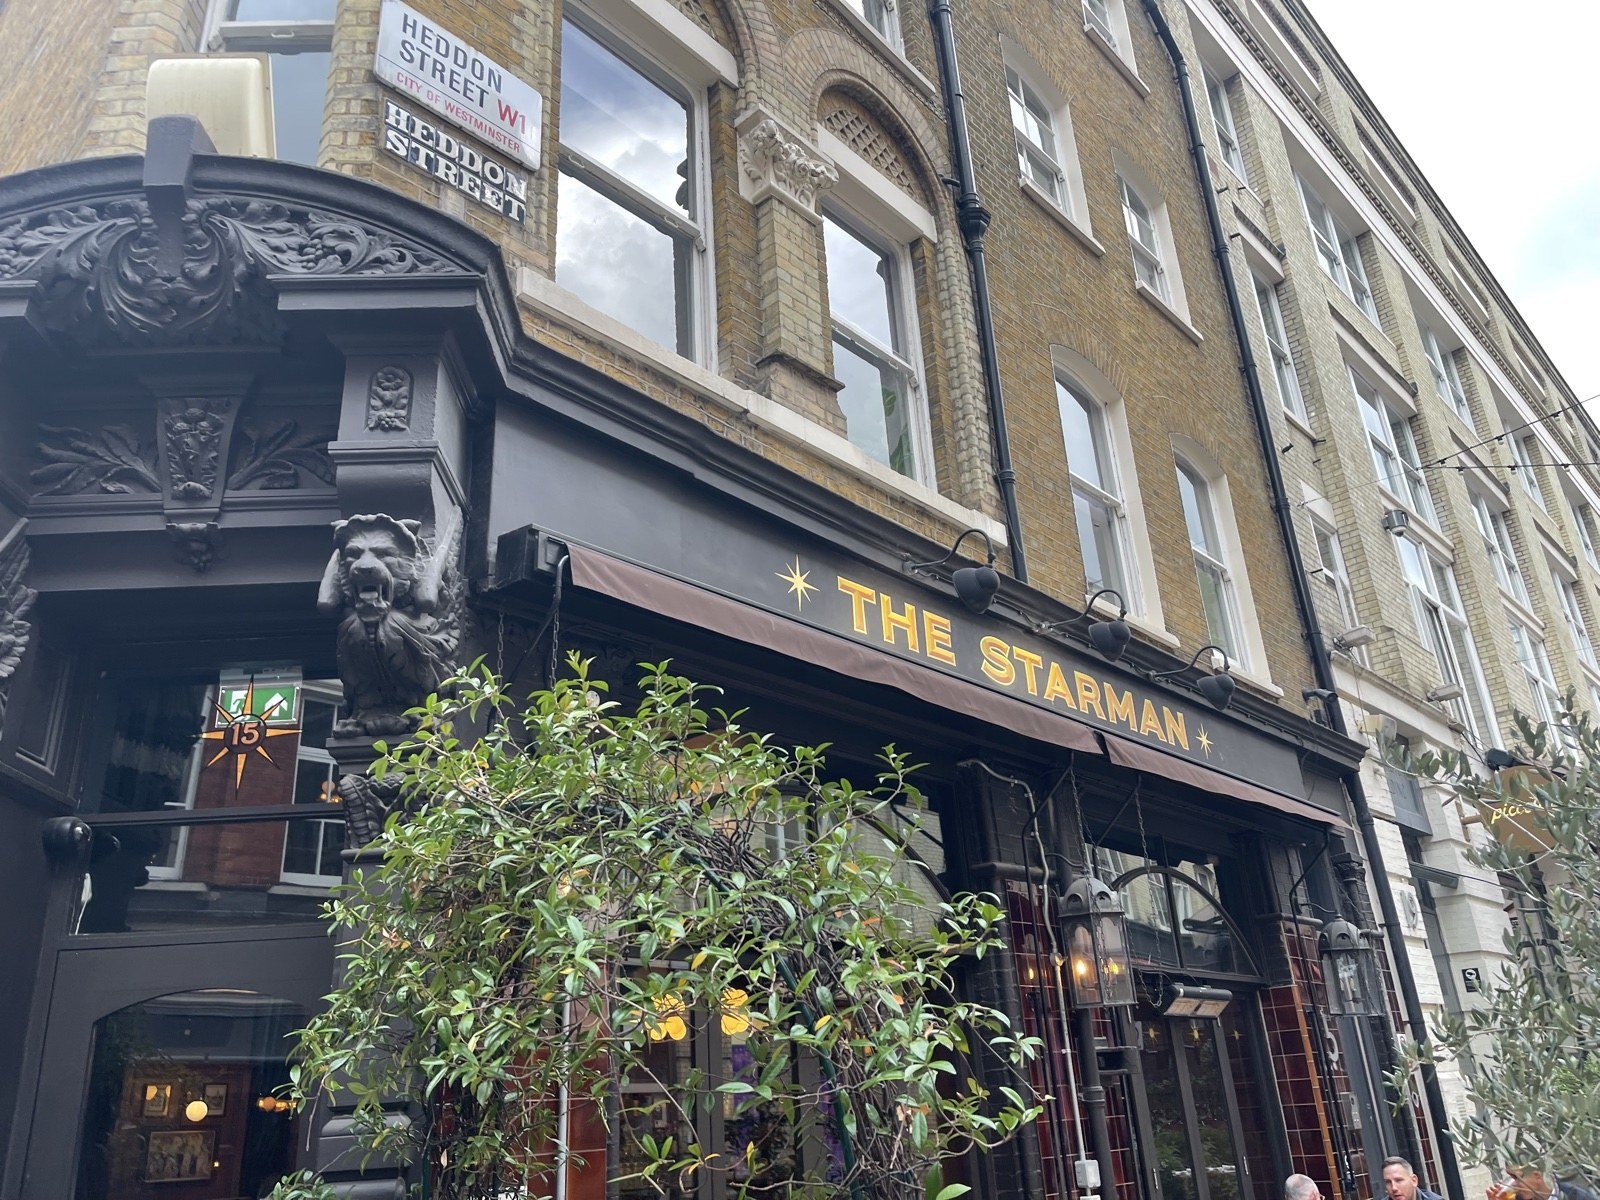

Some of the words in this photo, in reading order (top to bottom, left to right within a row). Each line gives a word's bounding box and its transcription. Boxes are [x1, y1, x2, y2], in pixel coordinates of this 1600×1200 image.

[399, 39, 490, 109] STREET
[497, 98, 526, 134] W1
[402, 13, 502, 93] HEDDON
[385, 101, 527, 199] HEDDON
[396, 72, 422, 93] CITY
[427, 90, 441, 104] OF
[444, 100, 520, 152] WESTMINSTER
[386, 129, 527, 221] STREET
[836, 575, 957, 667] THE
[979, 635, 1190, 751] STARMAN
[231, 722, 260, 746] 15
